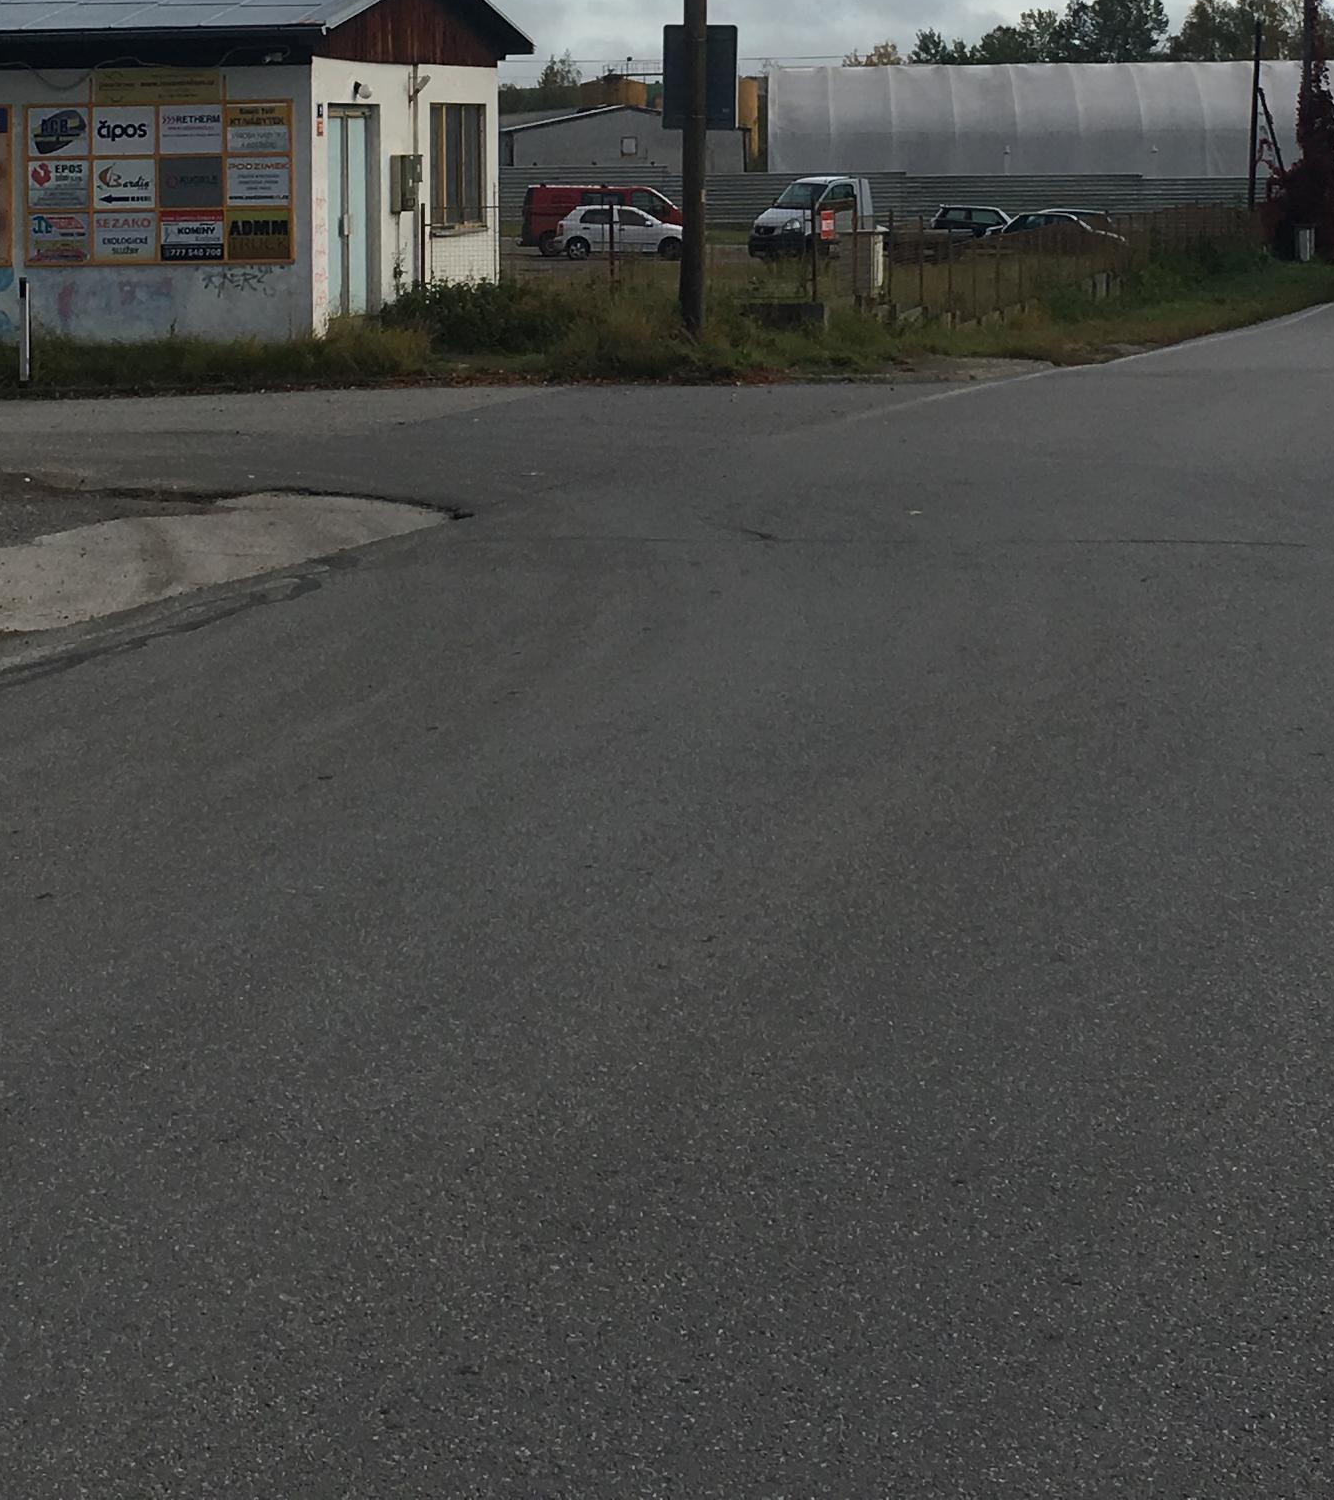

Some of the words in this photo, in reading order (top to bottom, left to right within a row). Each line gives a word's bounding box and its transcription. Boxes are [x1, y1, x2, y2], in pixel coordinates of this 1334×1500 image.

[175, 114, 221, 124] RETHERM
[97, 120, 147, 142] čipos
[54, 164, 83, 173] EPOS
[95, 218, 151, 228] SEZAKO
[229, 220, 288, 236] ADMM
